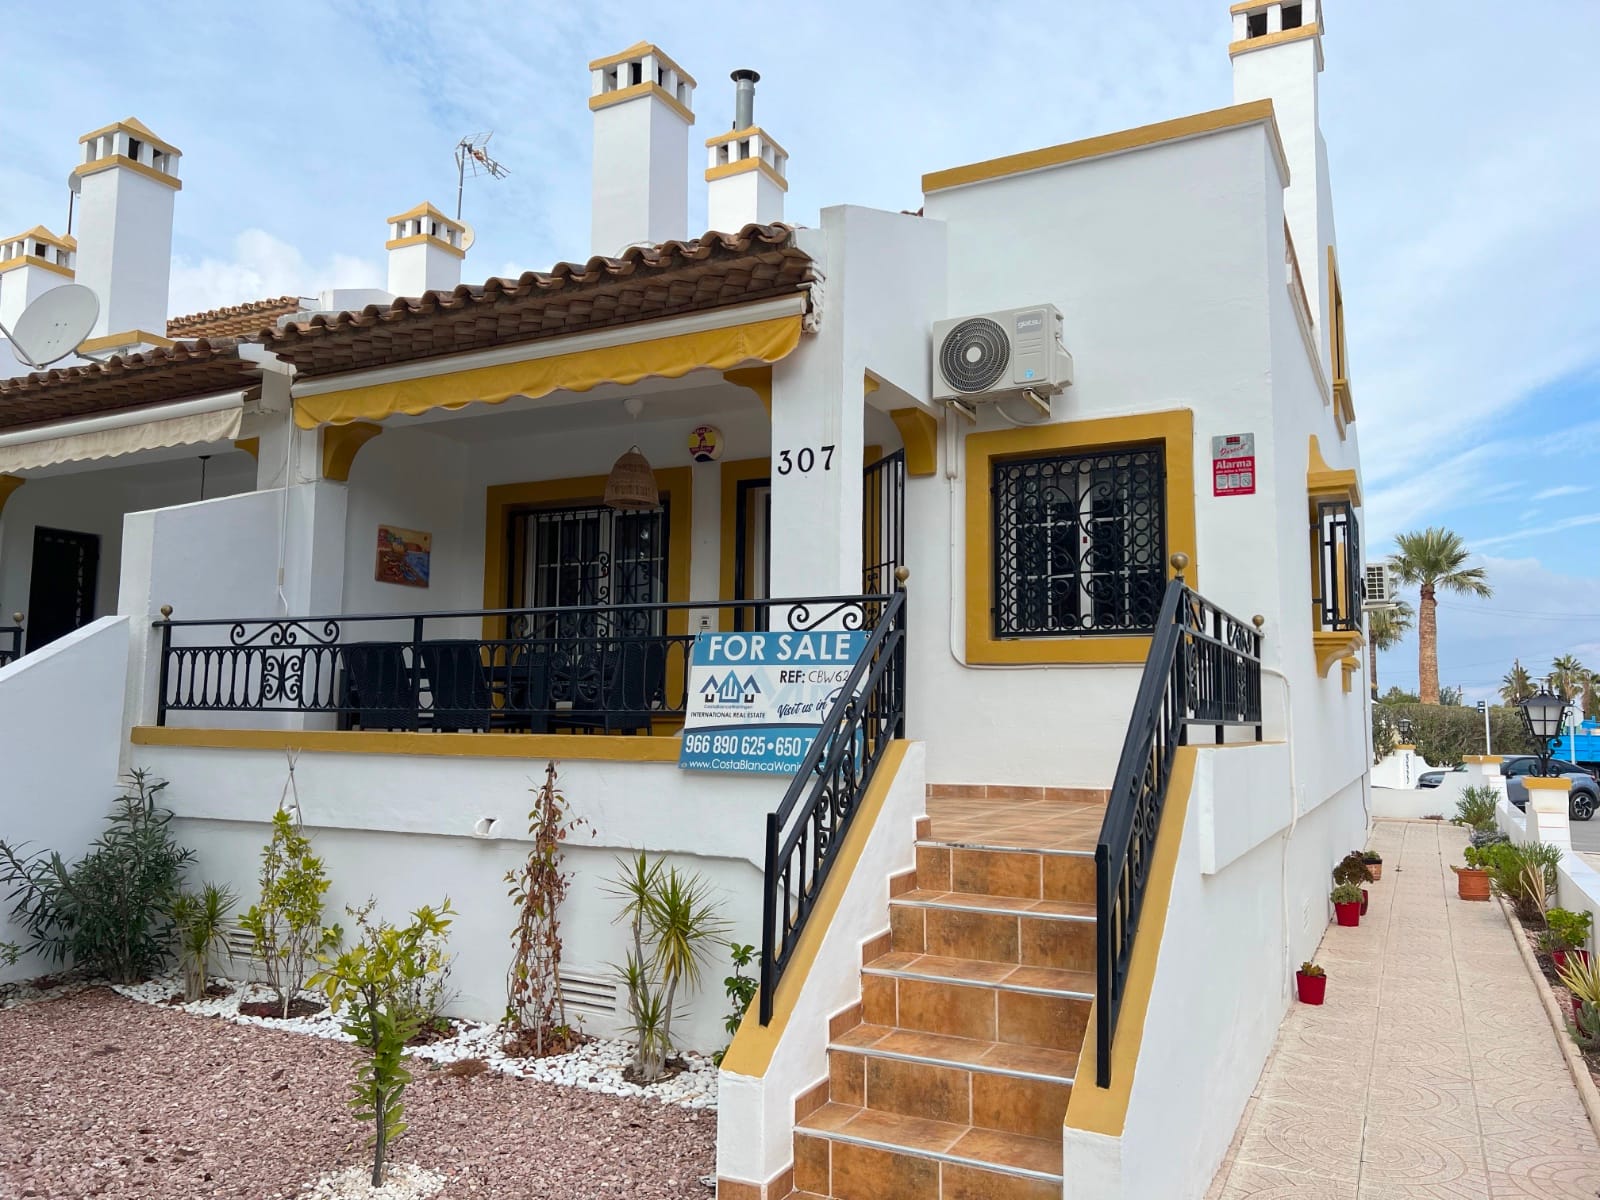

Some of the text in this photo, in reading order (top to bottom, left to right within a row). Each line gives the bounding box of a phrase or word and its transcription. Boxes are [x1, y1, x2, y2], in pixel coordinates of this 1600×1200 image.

[777, 445, 836, 475] 307
[1216, 460, 1252, 469] Alarma
[708, 634, 851, 661] FOR SALE
[780, 670, 805, 684] REF:
[777, 699, 828, 718] Visit us in
[685, 734, 710, 753] 966
[712, 735, 738, 754] 890
